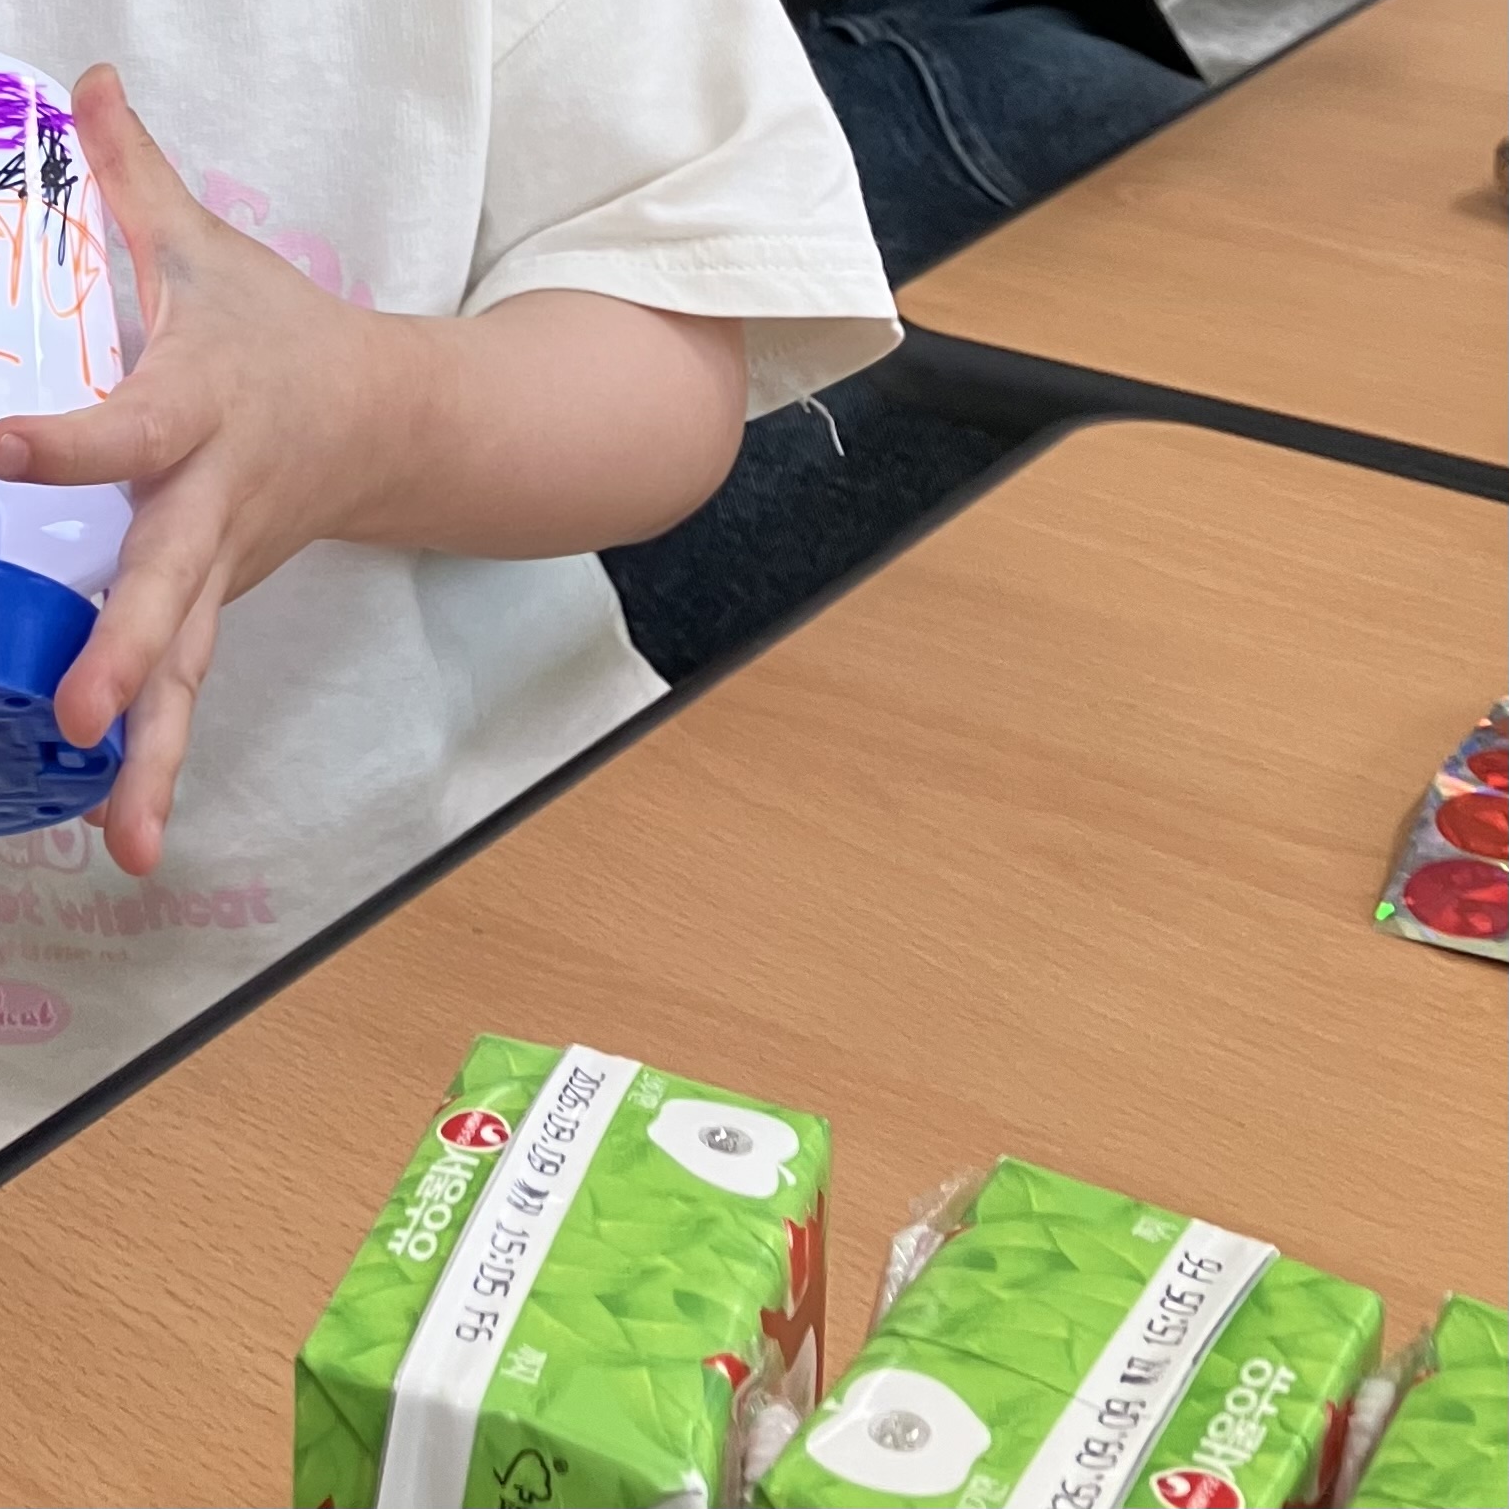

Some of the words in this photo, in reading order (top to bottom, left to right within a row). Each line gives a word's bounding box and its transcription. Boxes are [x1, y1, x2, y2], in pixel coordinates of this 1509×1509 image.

[52, 882, 277, 937] wishcat
[527, 1066, 606, 1176] 2026.09.09
[387, 1144, 481, 1263] 서울우유
[473, 1218, 530, 1298] 15:05
[1143, 1283, 1205, 1347] 15:05
[1177, 1250, 1222, 1285] F6
[455, 1305, 499, 1342] F6
[1192, 1357, 1297, 1482] 서울우유
